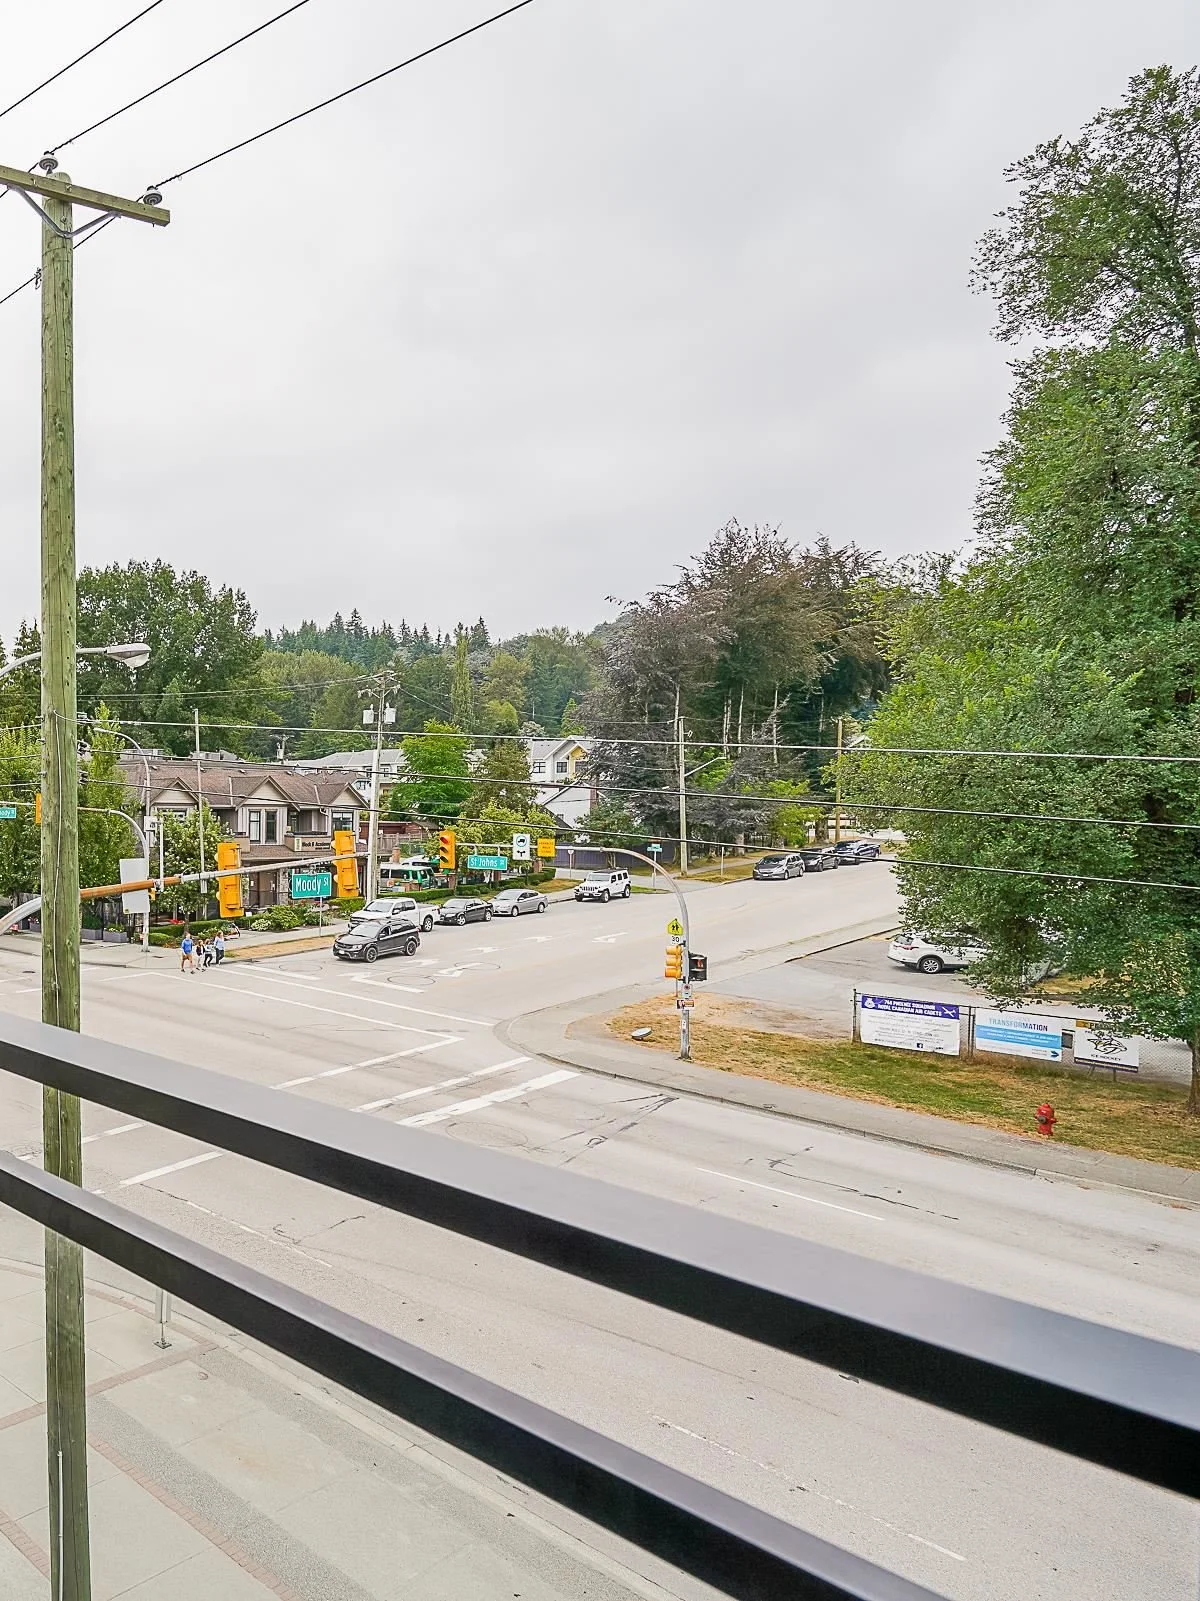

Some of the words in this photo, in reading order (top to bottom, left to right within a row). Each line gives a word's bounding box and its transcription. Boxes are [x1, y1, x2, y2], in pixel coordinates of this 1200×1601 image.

[470, 858, 477, 866] St
[479, 858, 497, 867] Johns
[296, 876, 320, 894] Moody
[324, 876, 328, 886] St
[989, 1018, 1048, 1032] TRANSFORMATION
